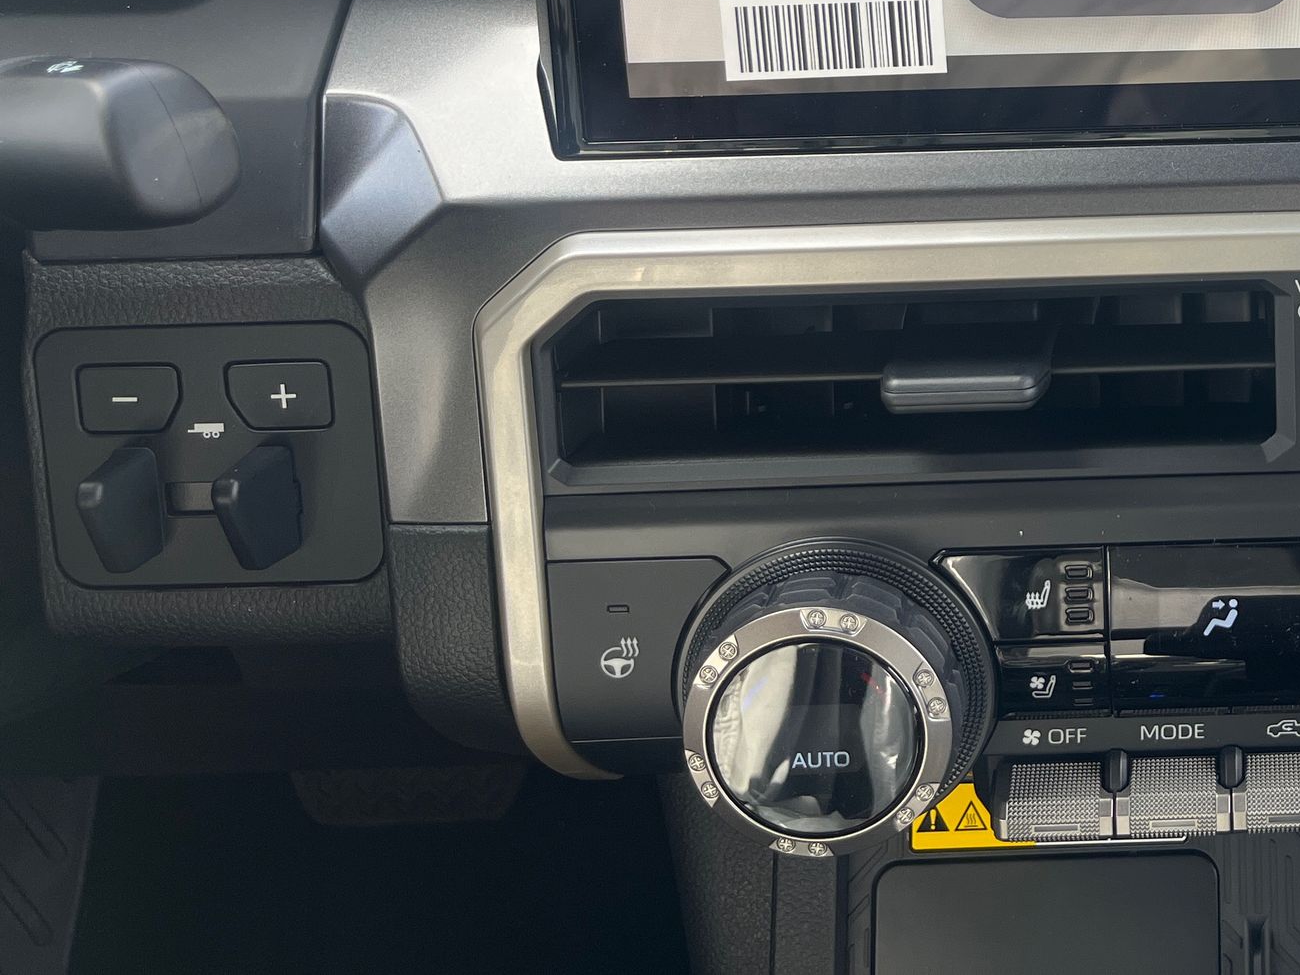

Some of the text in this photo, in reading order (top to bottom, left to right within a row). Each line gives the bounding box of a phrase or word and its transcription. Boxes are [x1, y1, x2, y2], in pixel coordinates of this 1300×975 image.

[1047, 727, 1087, 744] OFF
[1139, 722, 1206, 741] MODE
[791, 751, 850, 769] AUTO
